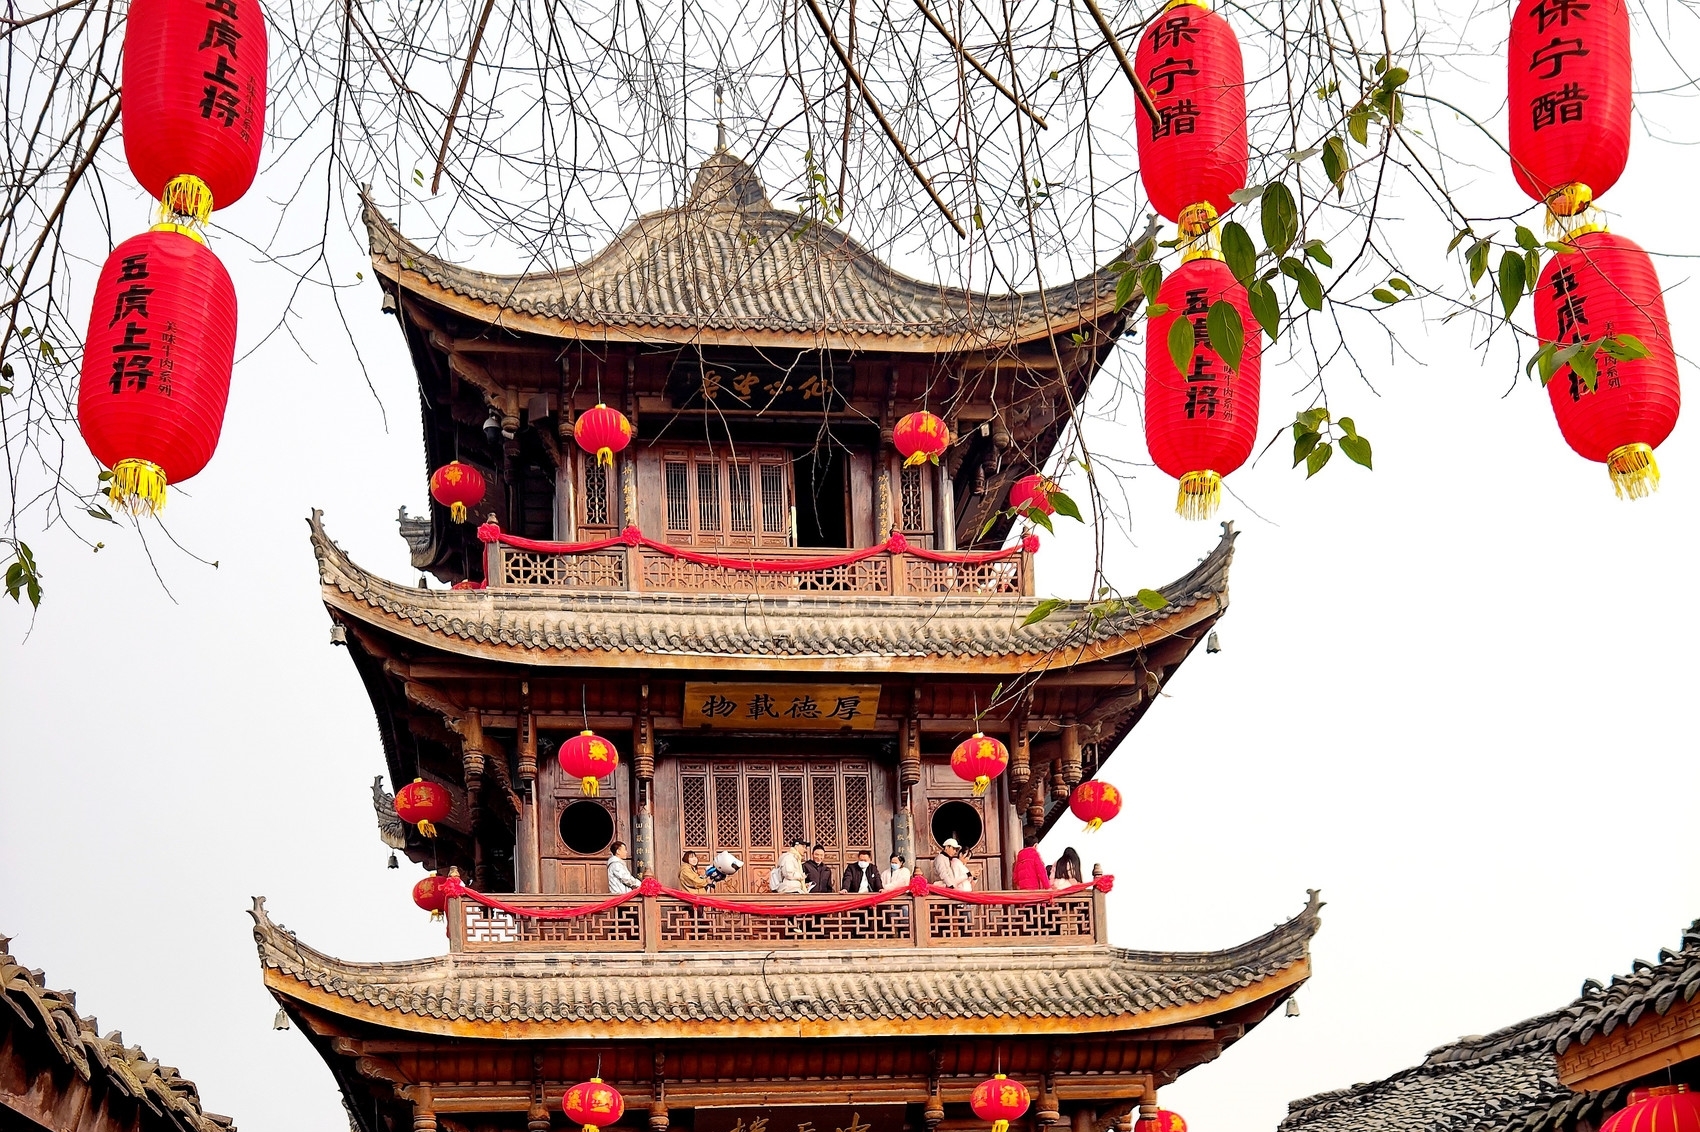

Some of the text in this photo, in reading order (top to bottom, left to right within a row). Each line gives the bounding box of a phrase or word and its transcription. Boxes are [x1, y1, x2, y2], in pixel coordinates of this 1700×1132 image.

[198, 0, 242, 128] 五虎上将
[1147, 17, 1201, 142] 保宁醋
[1529, 0, 1591, 132] 保宁醋
[108, 253, 156, 395] 五虎上将
[158, 321, 177, 397] 美味牛肉系列
[1603, 320, 1621, 389] 美味肉系列
[1223, 364, 1234, 421] 味牛肉系列
